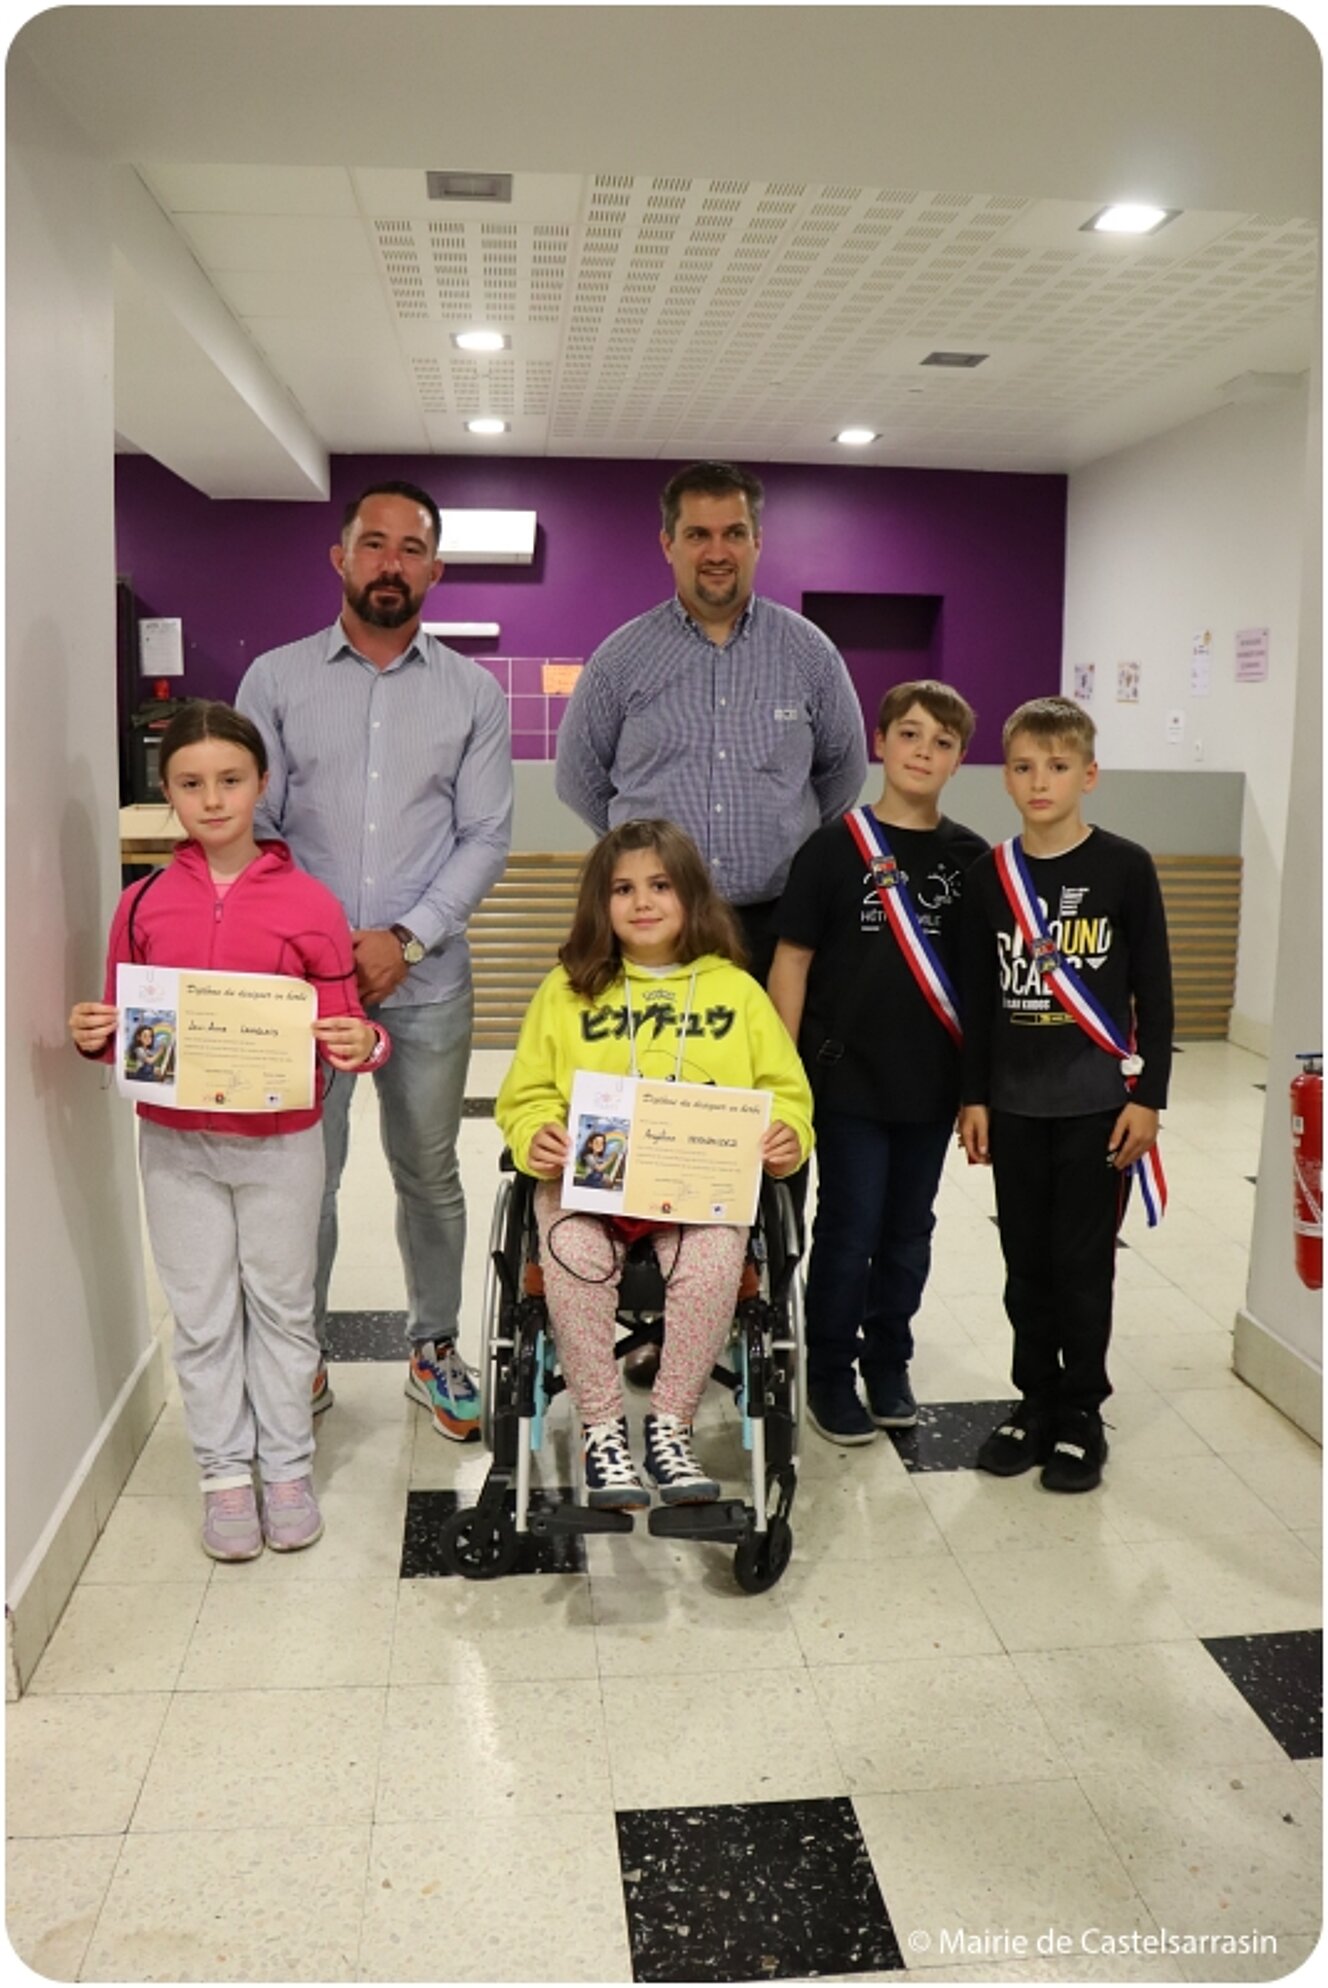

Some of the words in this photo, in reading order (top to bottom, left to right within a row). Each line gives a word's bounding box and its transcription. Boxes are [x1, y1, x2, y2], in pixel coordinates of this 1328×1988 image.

[581, 1003, 735, 1043] ピカチュウ
